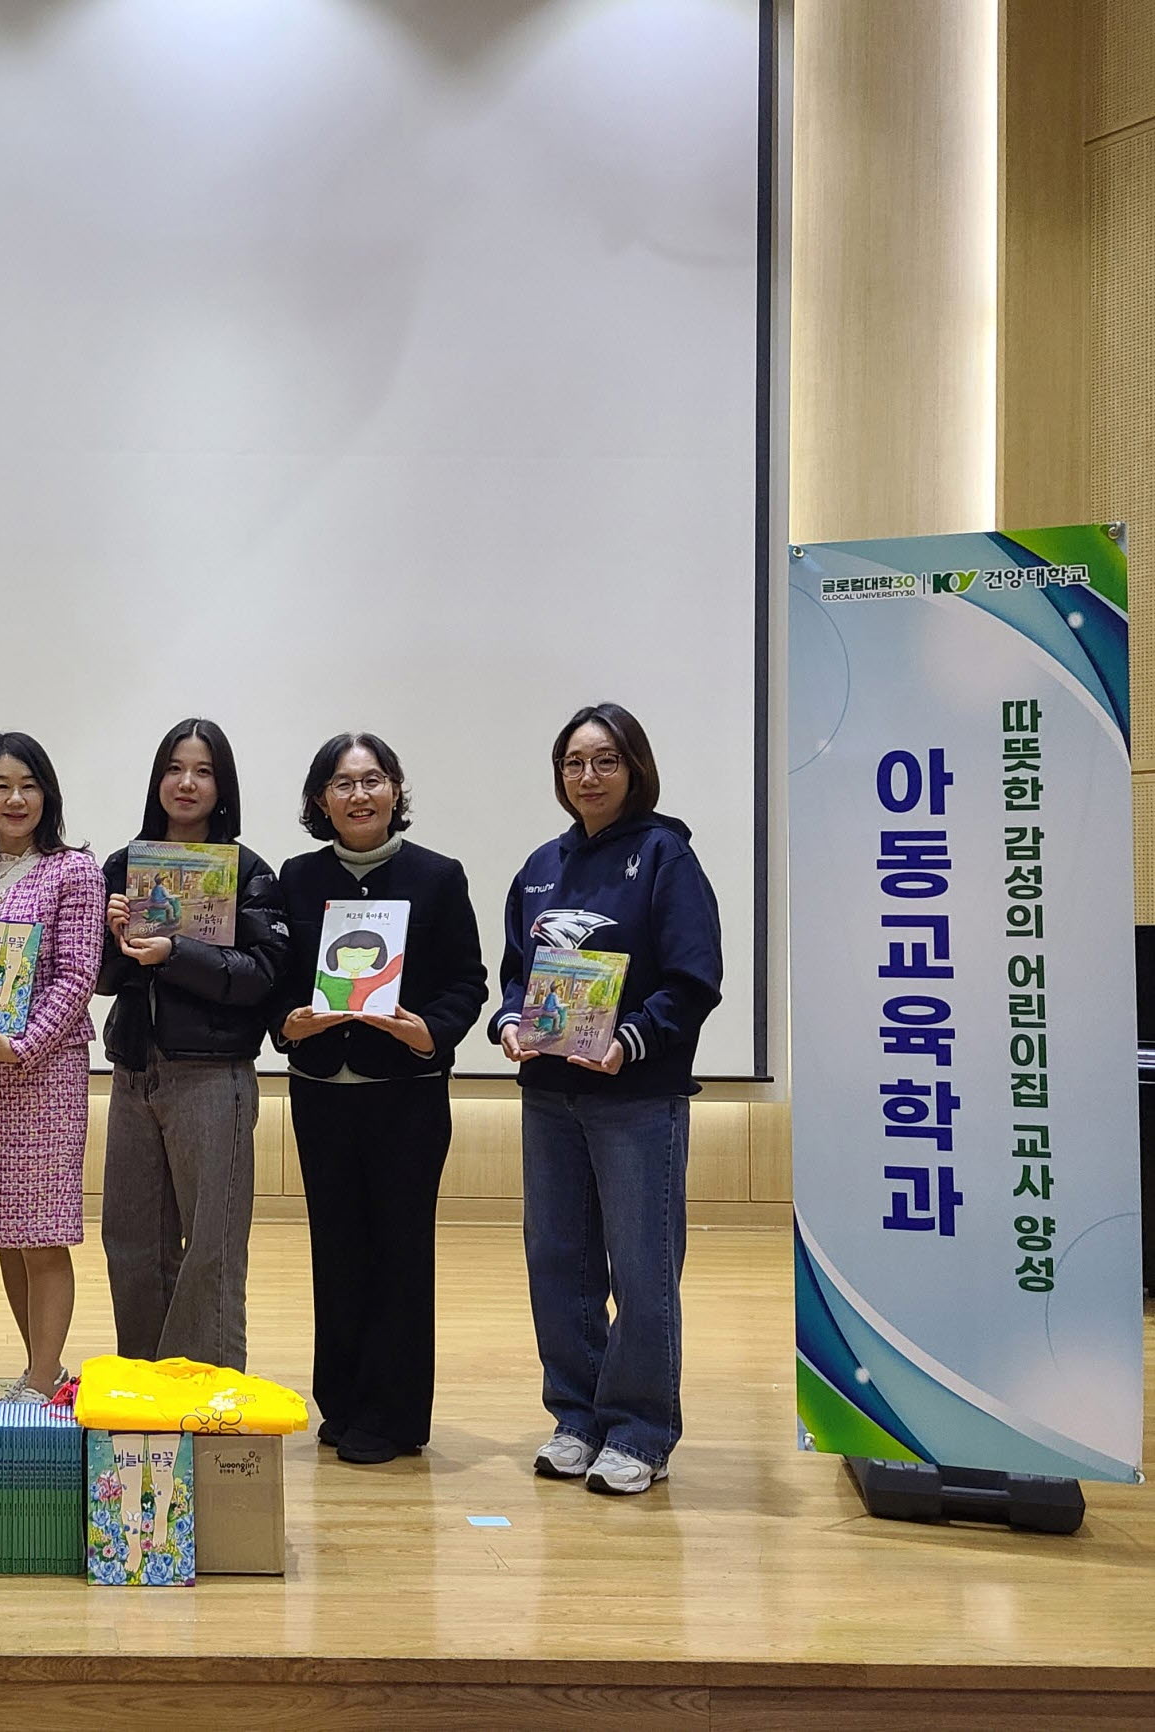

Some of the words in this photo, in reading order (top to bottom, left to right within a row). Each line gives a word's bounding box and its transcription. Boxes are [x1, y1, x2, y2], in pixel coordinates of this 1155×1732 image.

[821, 574, 916, 593] 글로컬대학30
[821, 592, 855, 602] GLOCAL
[855, 589, 916, 600] UNIVERSITY30
[983, 565, 1090, 590] 건양대학교
[1002, 699, 1044, 812] 따뜻한
[346, 912, 363, 920] 최고의
[365, 912, 390, 920] 육아휴직
[1003, 826, 1045, 939] 감성의
[876, 747, 964, 1237] 아동교육학과
[1007, 954, 1049, 1109] 어린이집
[1012, 1123, 1054, 1201] 교사
[1013, 1215, 1056, 1293] 양성
